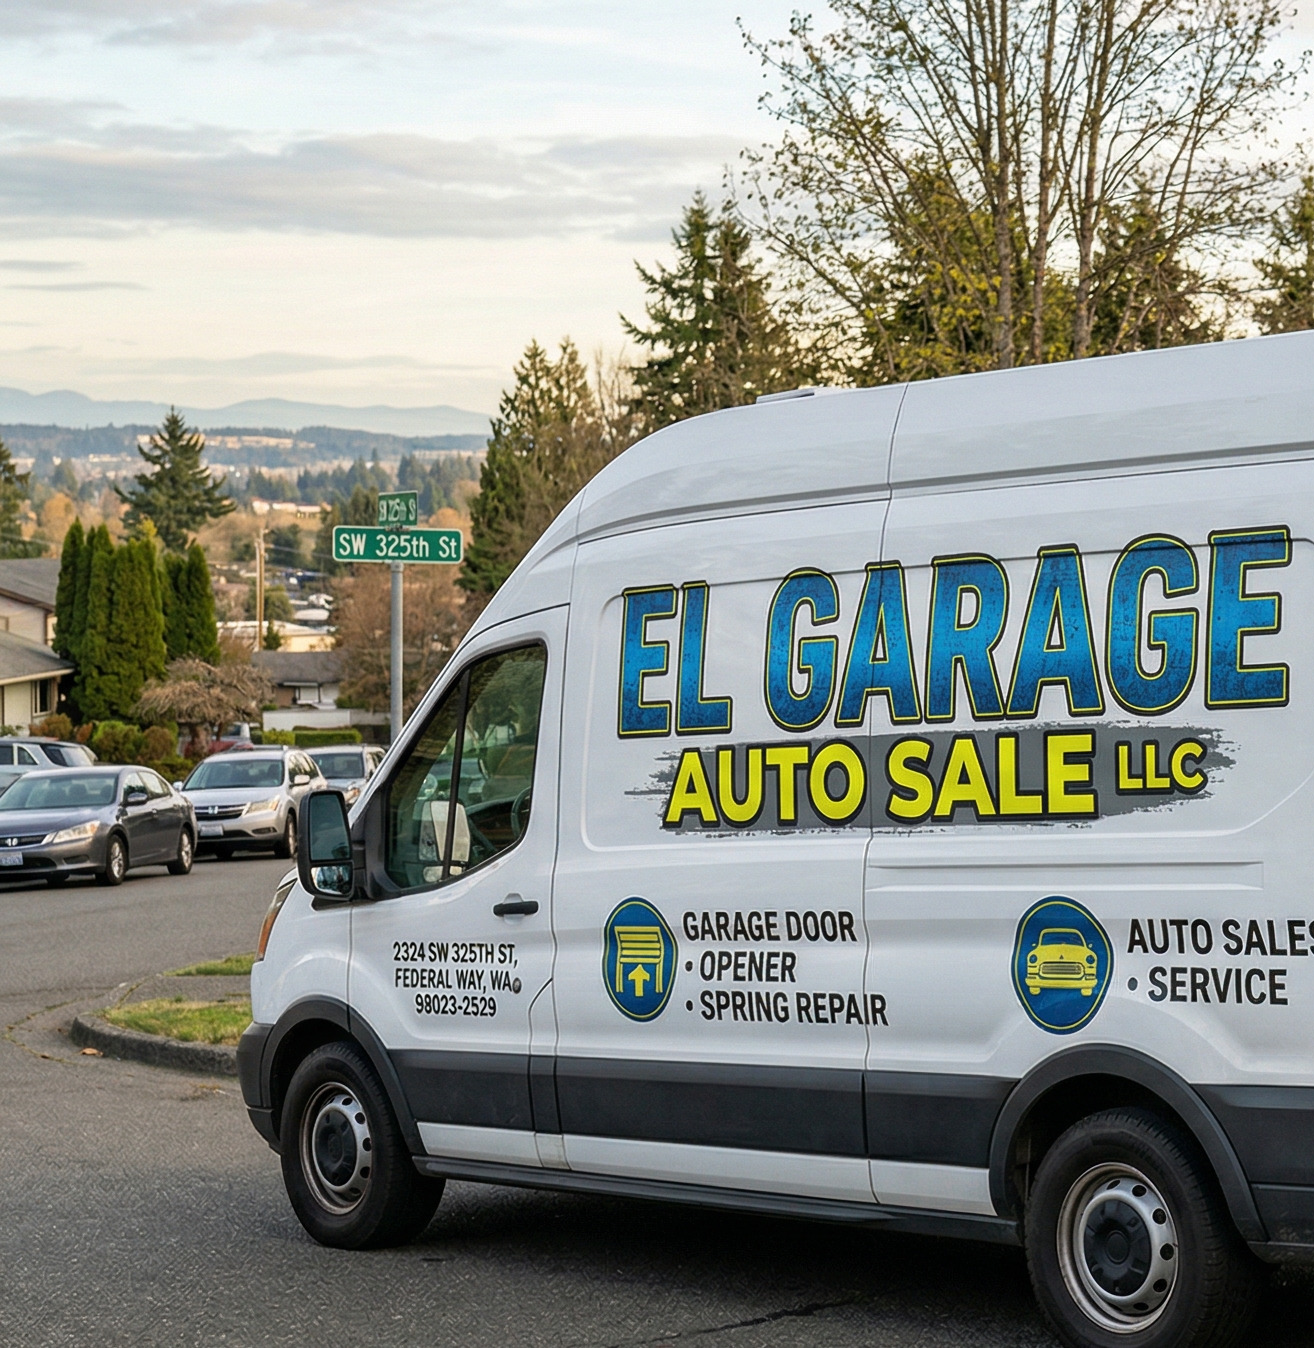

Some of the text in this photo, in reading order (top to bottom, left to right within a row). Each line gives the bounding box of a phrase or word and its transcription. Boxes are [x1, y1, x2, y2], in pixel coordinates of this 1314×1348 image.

[339, 533, 457, 558] SW 325th St
[617, 525, 1291, 738] EL GARAGE
[662, 730, 1207, 828] AUTO SALE LLC
[683, 910, 858, 942] GARAGE DOOR
[1127, 919, 1213, 955] AUTO
[393, 941, 518, 968] 2324 SW 325TH ST,
[700, 951, 796, 983] OPENER
[395, 968, 452, 989] FEDERAL
[456, 969, 486, 994] WAY,
[1148, 966, 1288, 1005] SERVICE
[415, 993, 497, 1017] 98023-2529
[701, 990, 889, 1026] SPRING REPAIR
